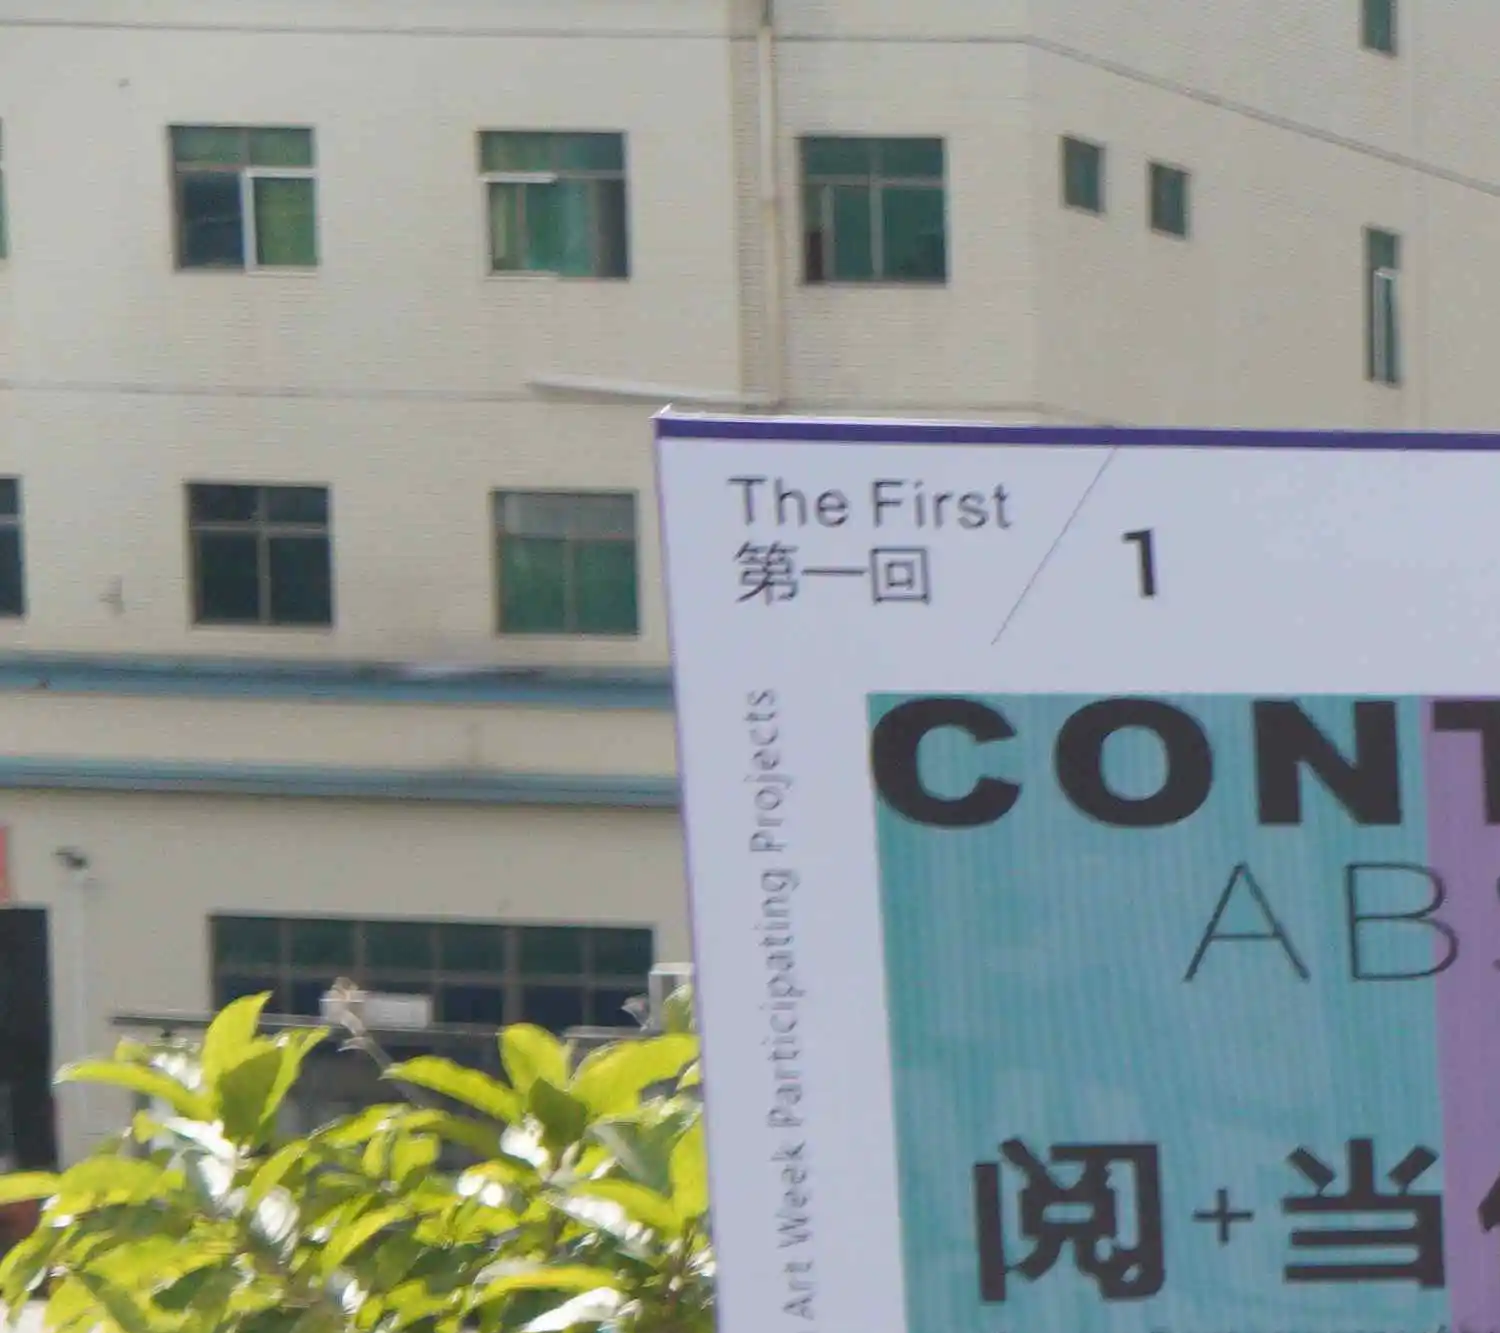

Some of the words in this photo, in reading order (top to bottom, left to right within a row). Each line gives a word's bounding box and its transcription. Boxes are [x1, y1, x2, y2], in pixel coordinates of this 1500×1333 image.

[729, 475, 849, 528] The
[873, 478, 1012, 531] First
[736, 541, 932, 606] 第一回
[1122, 529, 1159, 598] 1
[741, 686, 795, 856] Projects
[750, 866, 807, 1129] Participating
[768, 1141, 815, 1251] Week
[777, 1257, 819, 1323] Art
